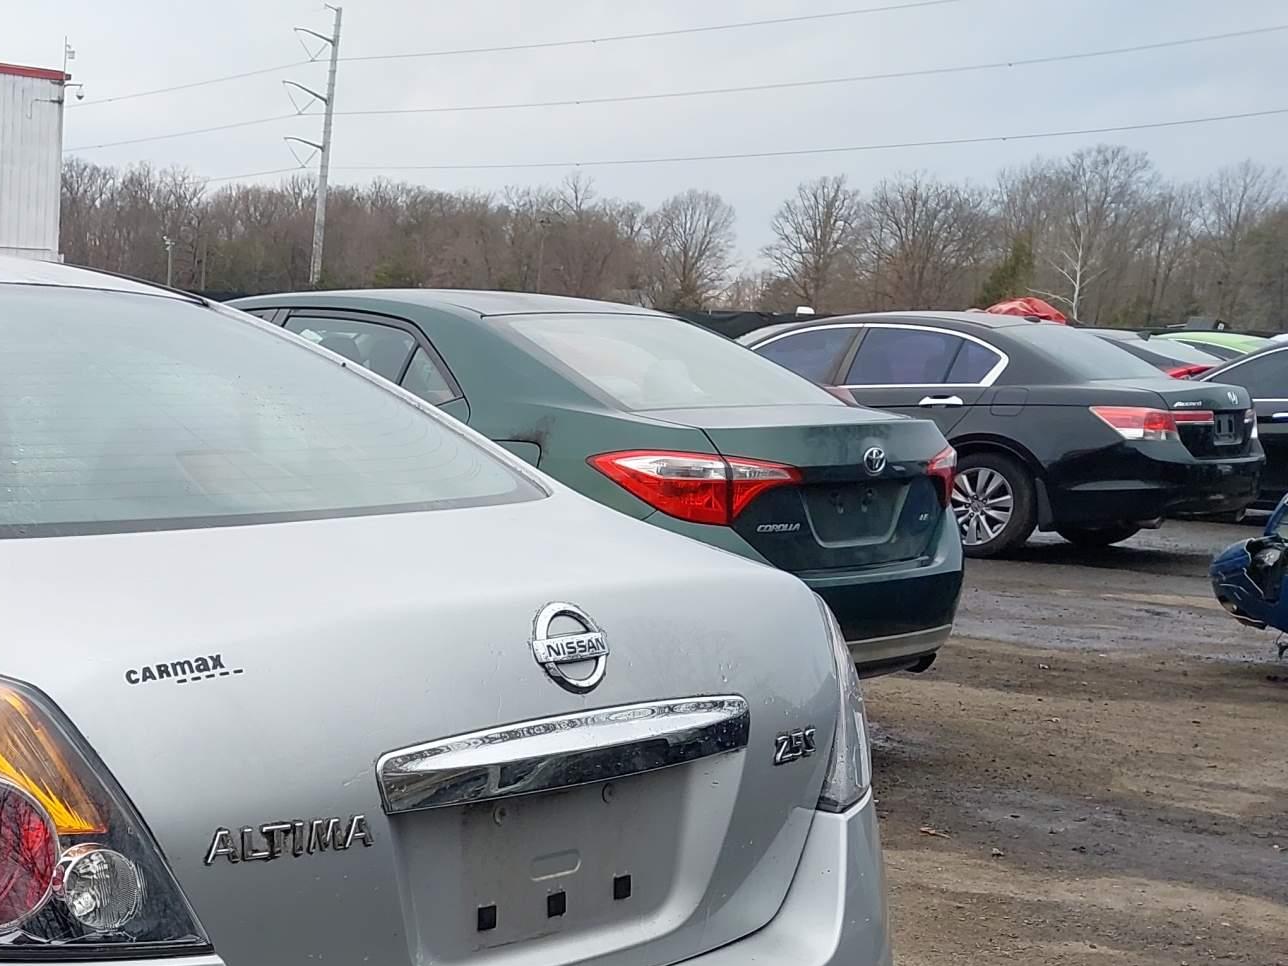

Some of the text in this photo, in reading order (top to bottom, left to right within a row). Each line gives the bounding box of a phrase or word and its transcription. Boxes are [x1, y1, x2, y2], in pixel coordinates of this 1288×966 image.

[756, 522, 801, 533] COROLLA
[546, 637, 606, 659] NISSAN
[204, 814, 375, 865] ALTIMA
